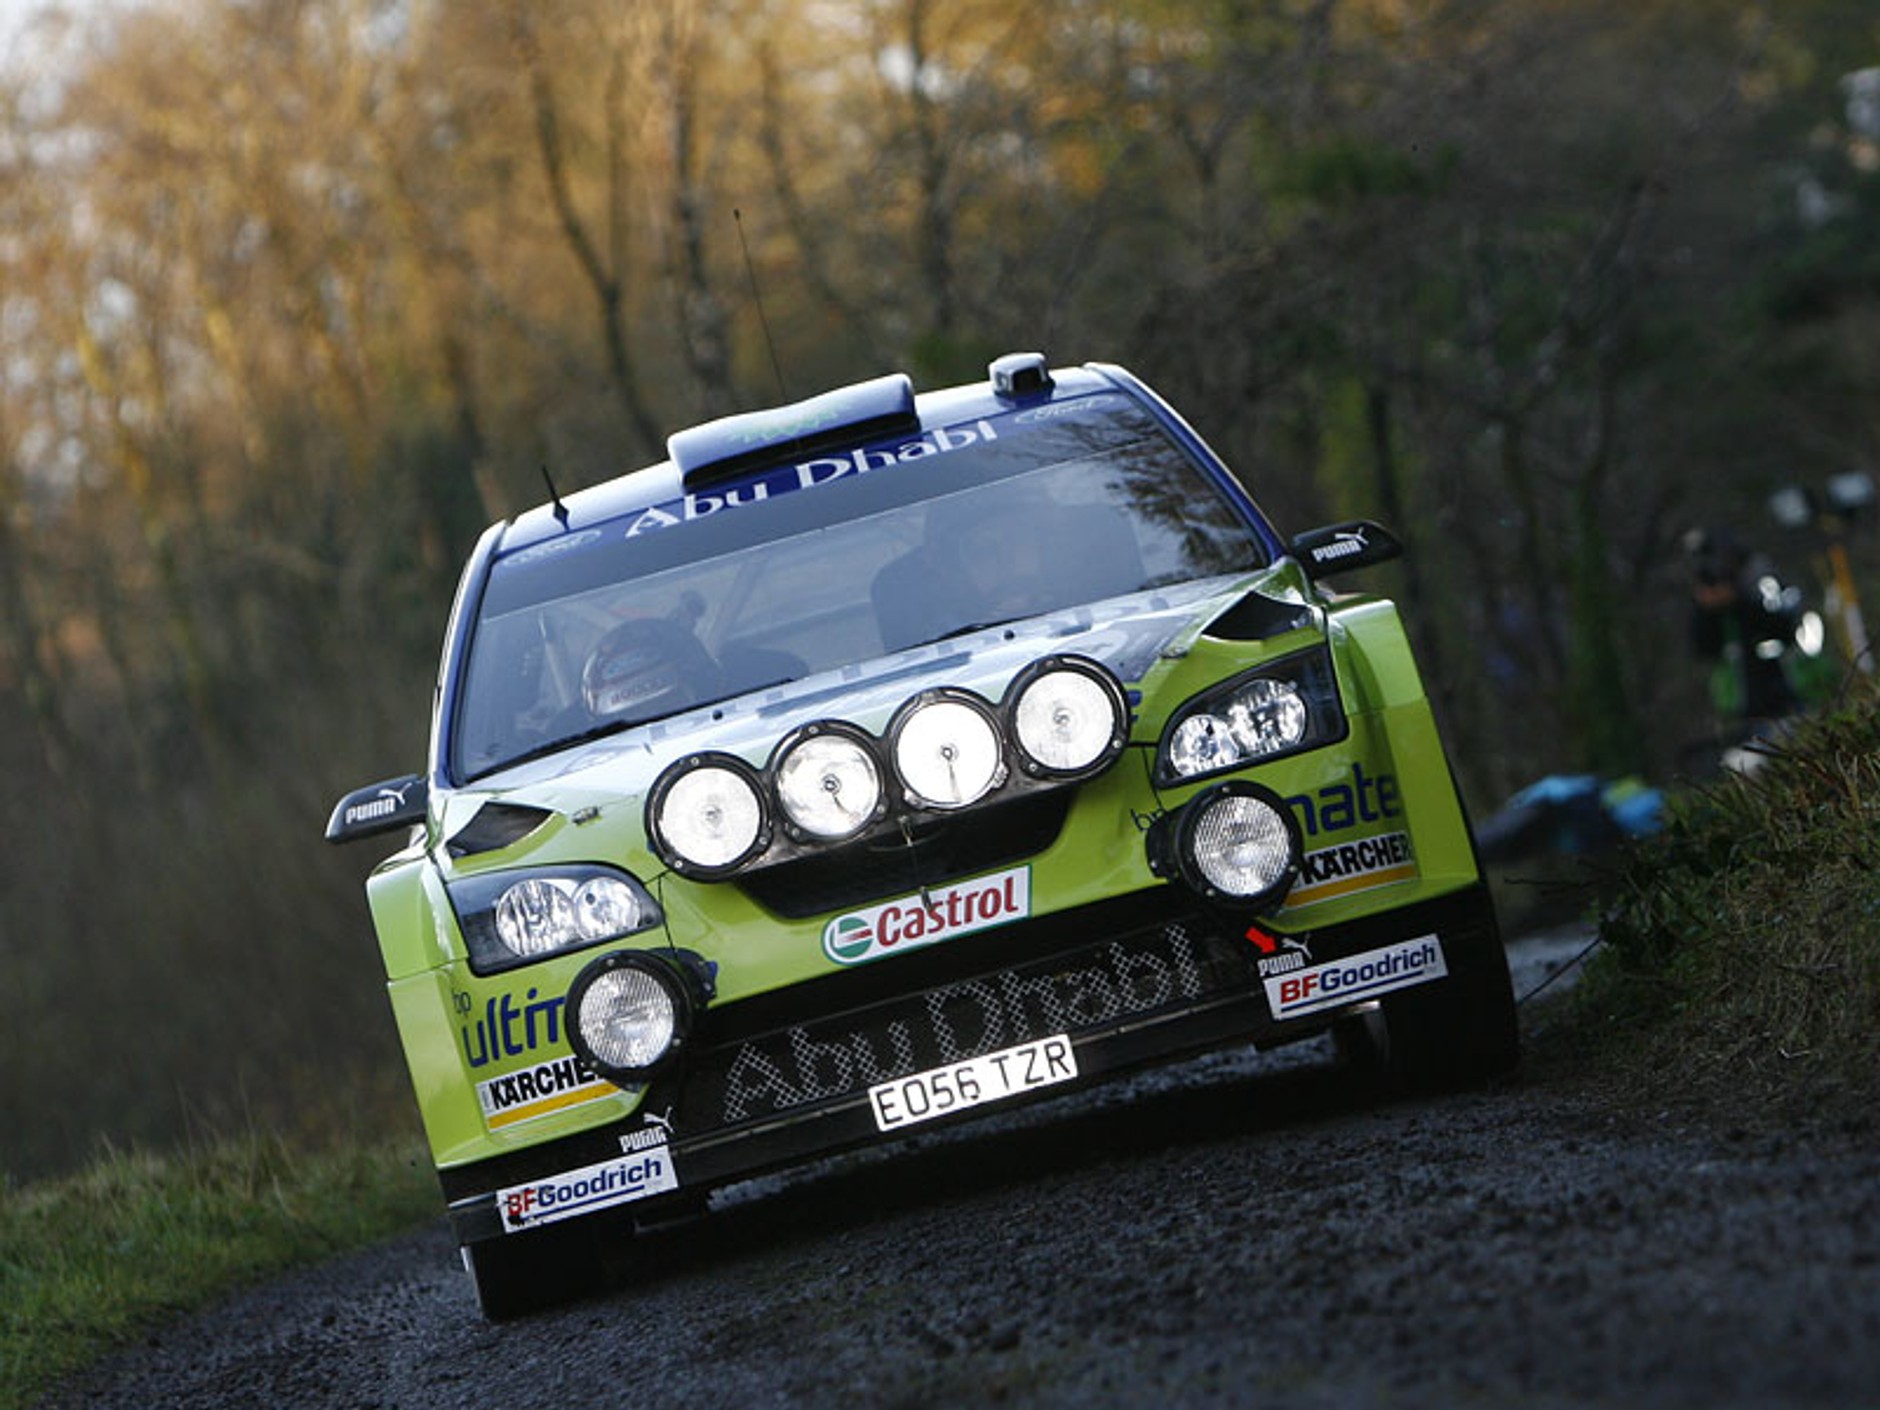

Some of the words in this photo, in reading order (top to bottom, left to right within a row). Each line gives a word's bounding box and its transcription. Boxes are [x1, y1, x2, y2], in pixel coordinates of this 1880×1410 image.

[625, 482, 769, 538] Abu
[1311, 539, 1361, 562] PUMA
[345, 797, 396, 824] PUMA
[876, 876, 1019, 947] Castrol
[1257, 950, 1305, 977] PUMA
[1279, 944, 1437, 1004] BFGoodrich
[461, 987, 567, 1068] ultim
[488, 1057, 598, 1110] KÄRCHE
[724, 1020, 916, 1121] Abu
[989, 1039, 1071, 1091] TZR
[618, 1125, 668, 1153] PUMA
[506, 1157, 662, 1217] BFGoodrich
